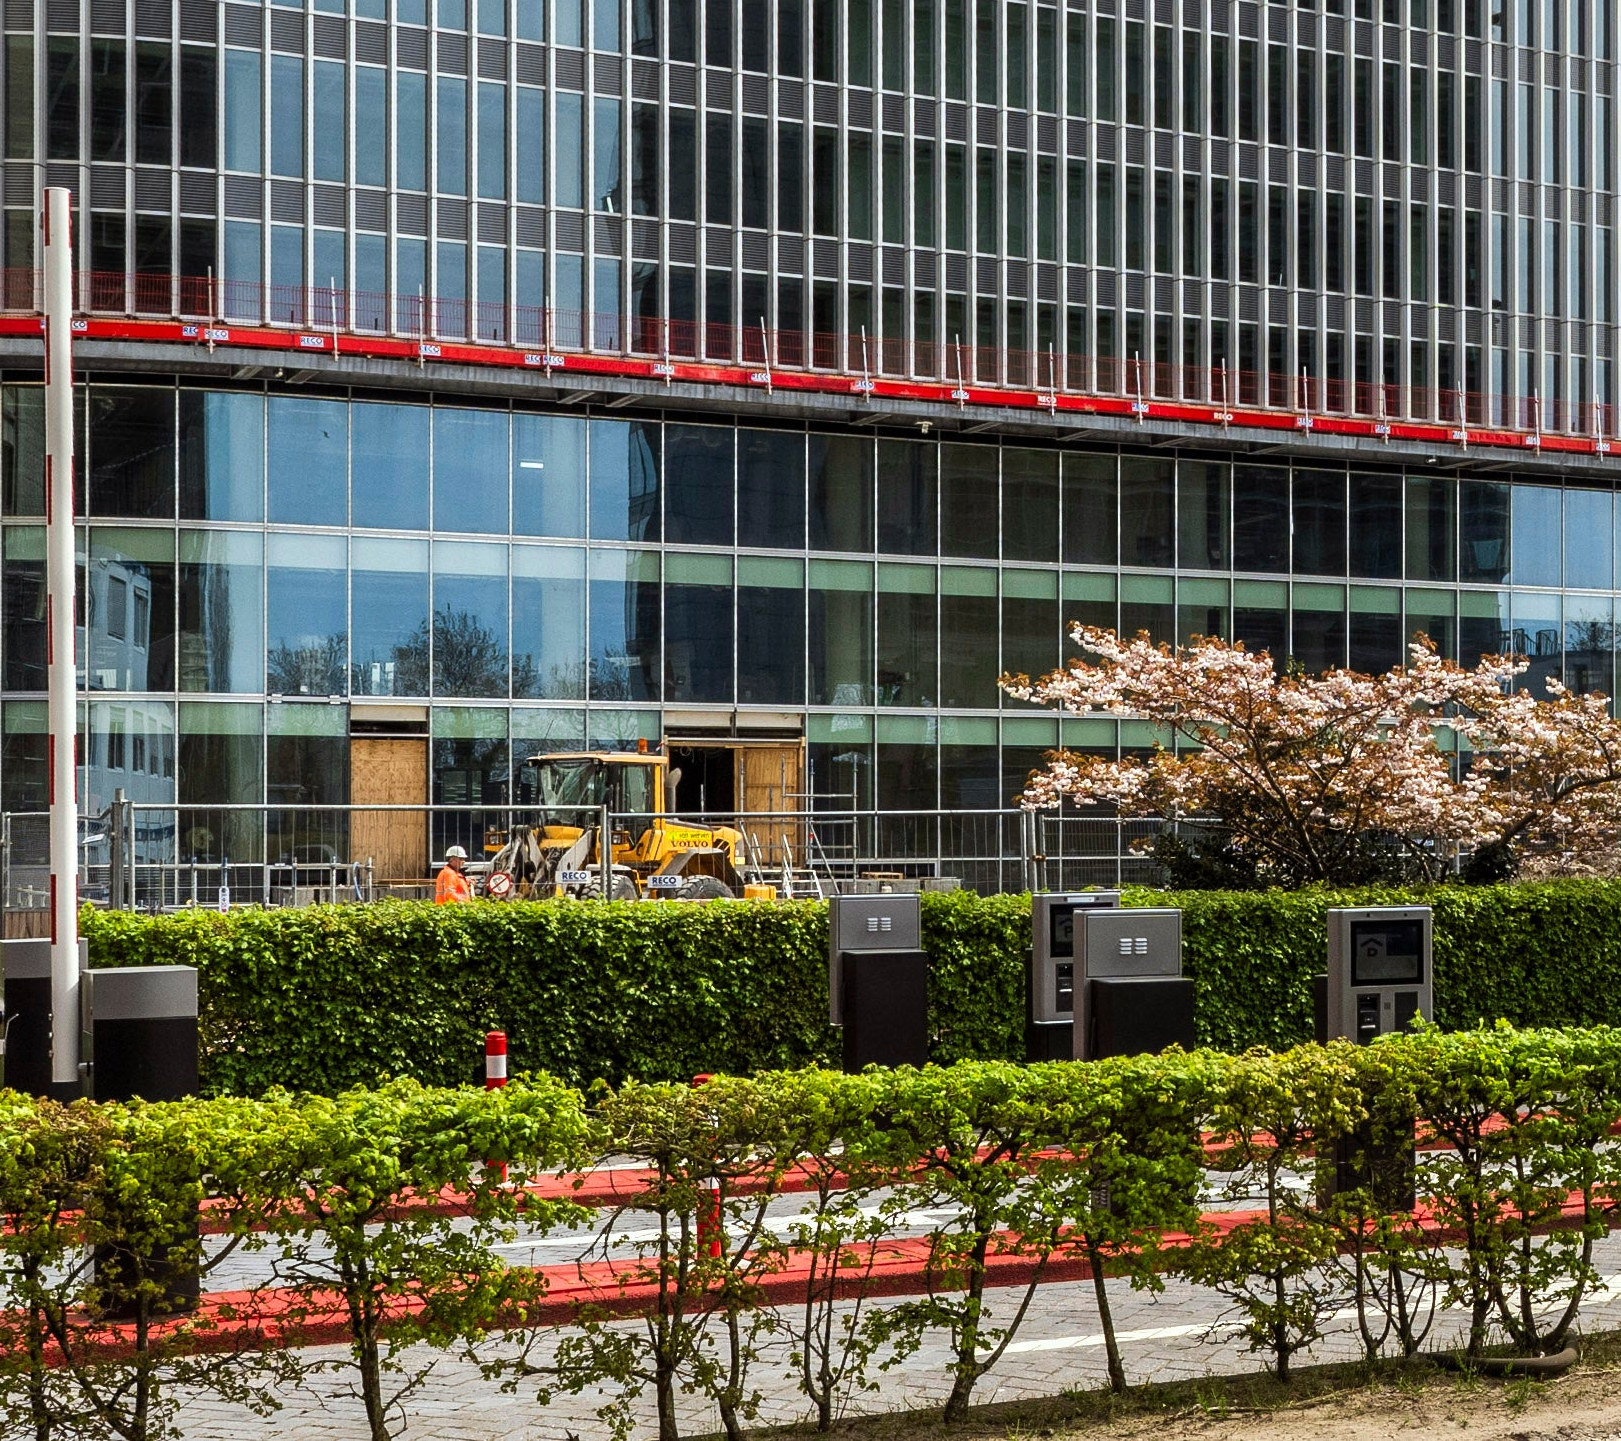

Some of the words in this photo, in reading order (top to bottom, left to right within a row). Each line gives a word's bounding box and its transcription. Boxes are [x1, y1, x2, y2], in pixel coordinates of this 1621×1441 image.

[301, 336, 322, 345] RECO
[671, 840, 709, 848] VOLVO
[562, 871, 587, 881] RECO
[652, 876, 677, 884] RECO
